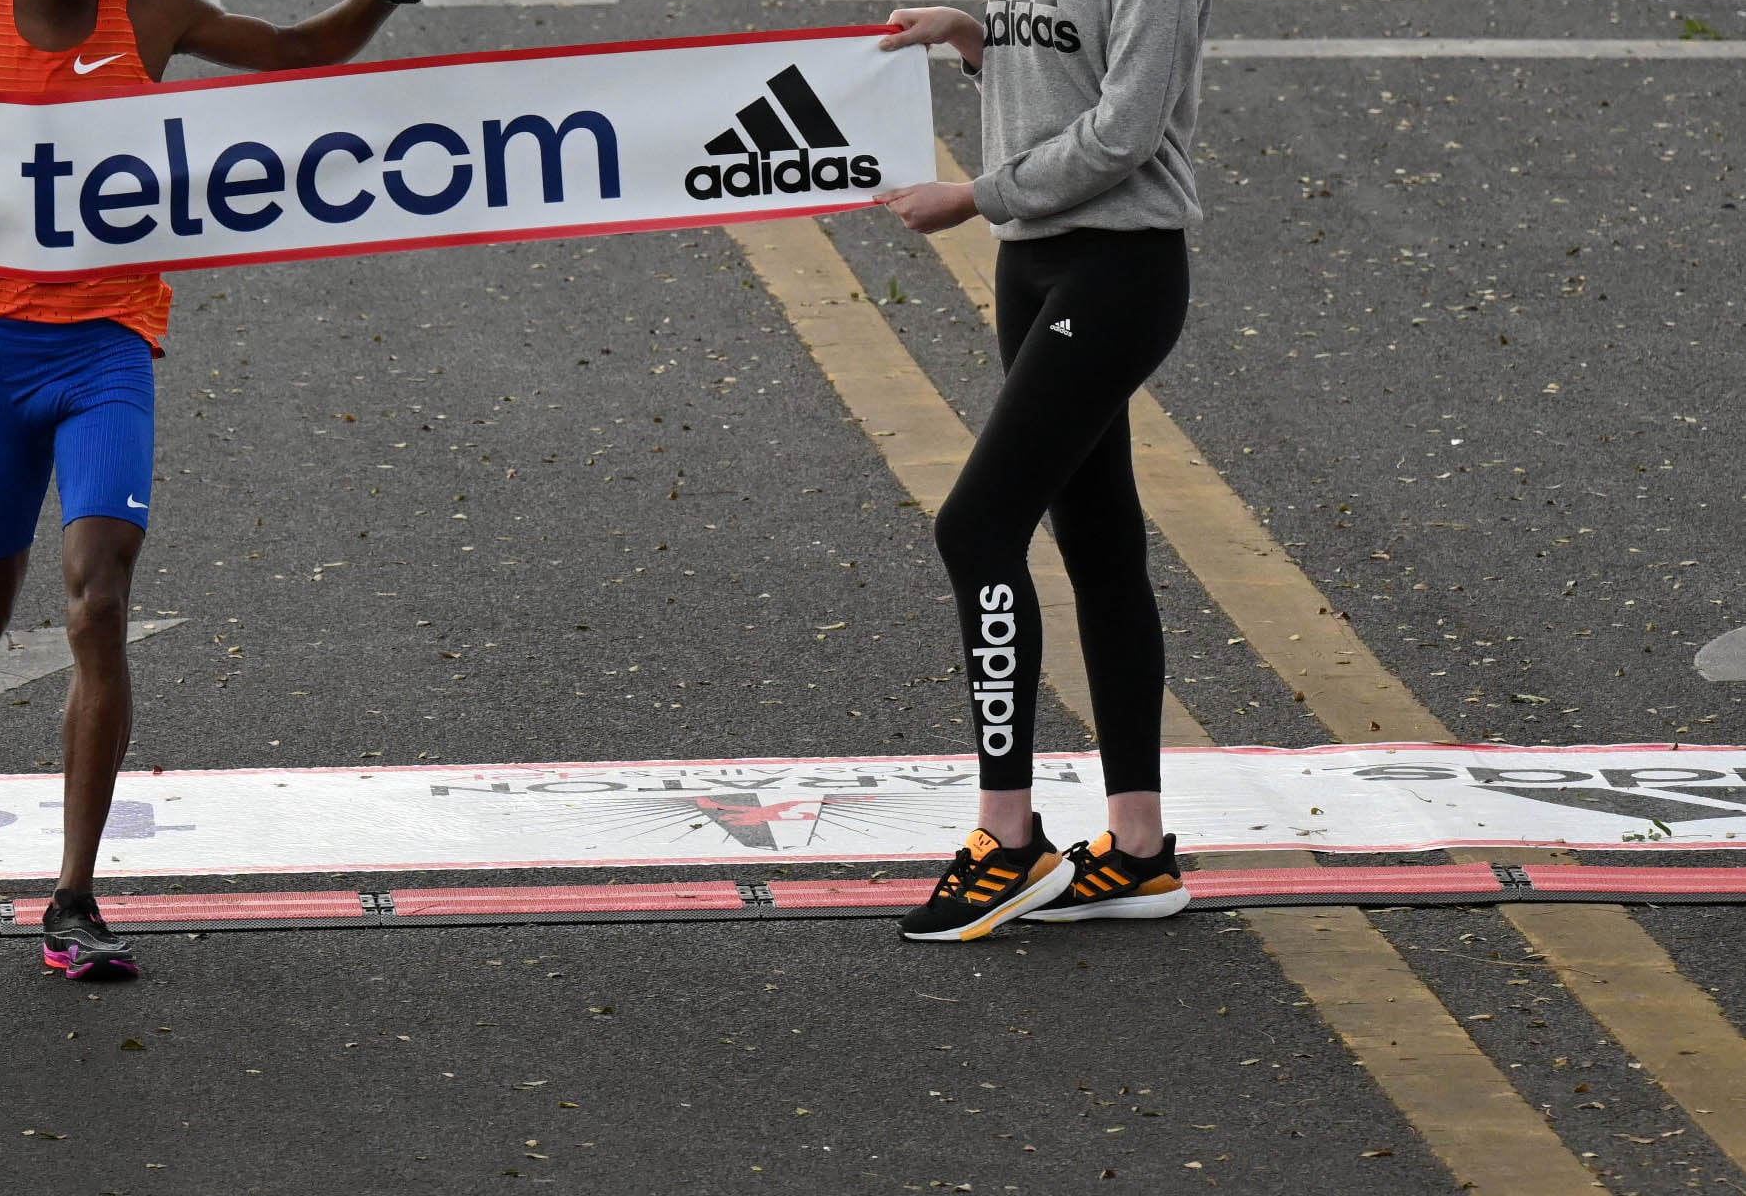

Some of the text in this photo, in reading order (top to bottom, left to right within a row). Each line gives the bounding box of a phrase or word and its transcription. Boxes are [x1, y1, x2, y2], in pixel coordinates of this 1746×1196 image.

[21, 110, 620, 248] telecom
[685, 148, 882, 200] adidas
[973, 583, 1017, 757] adidas
